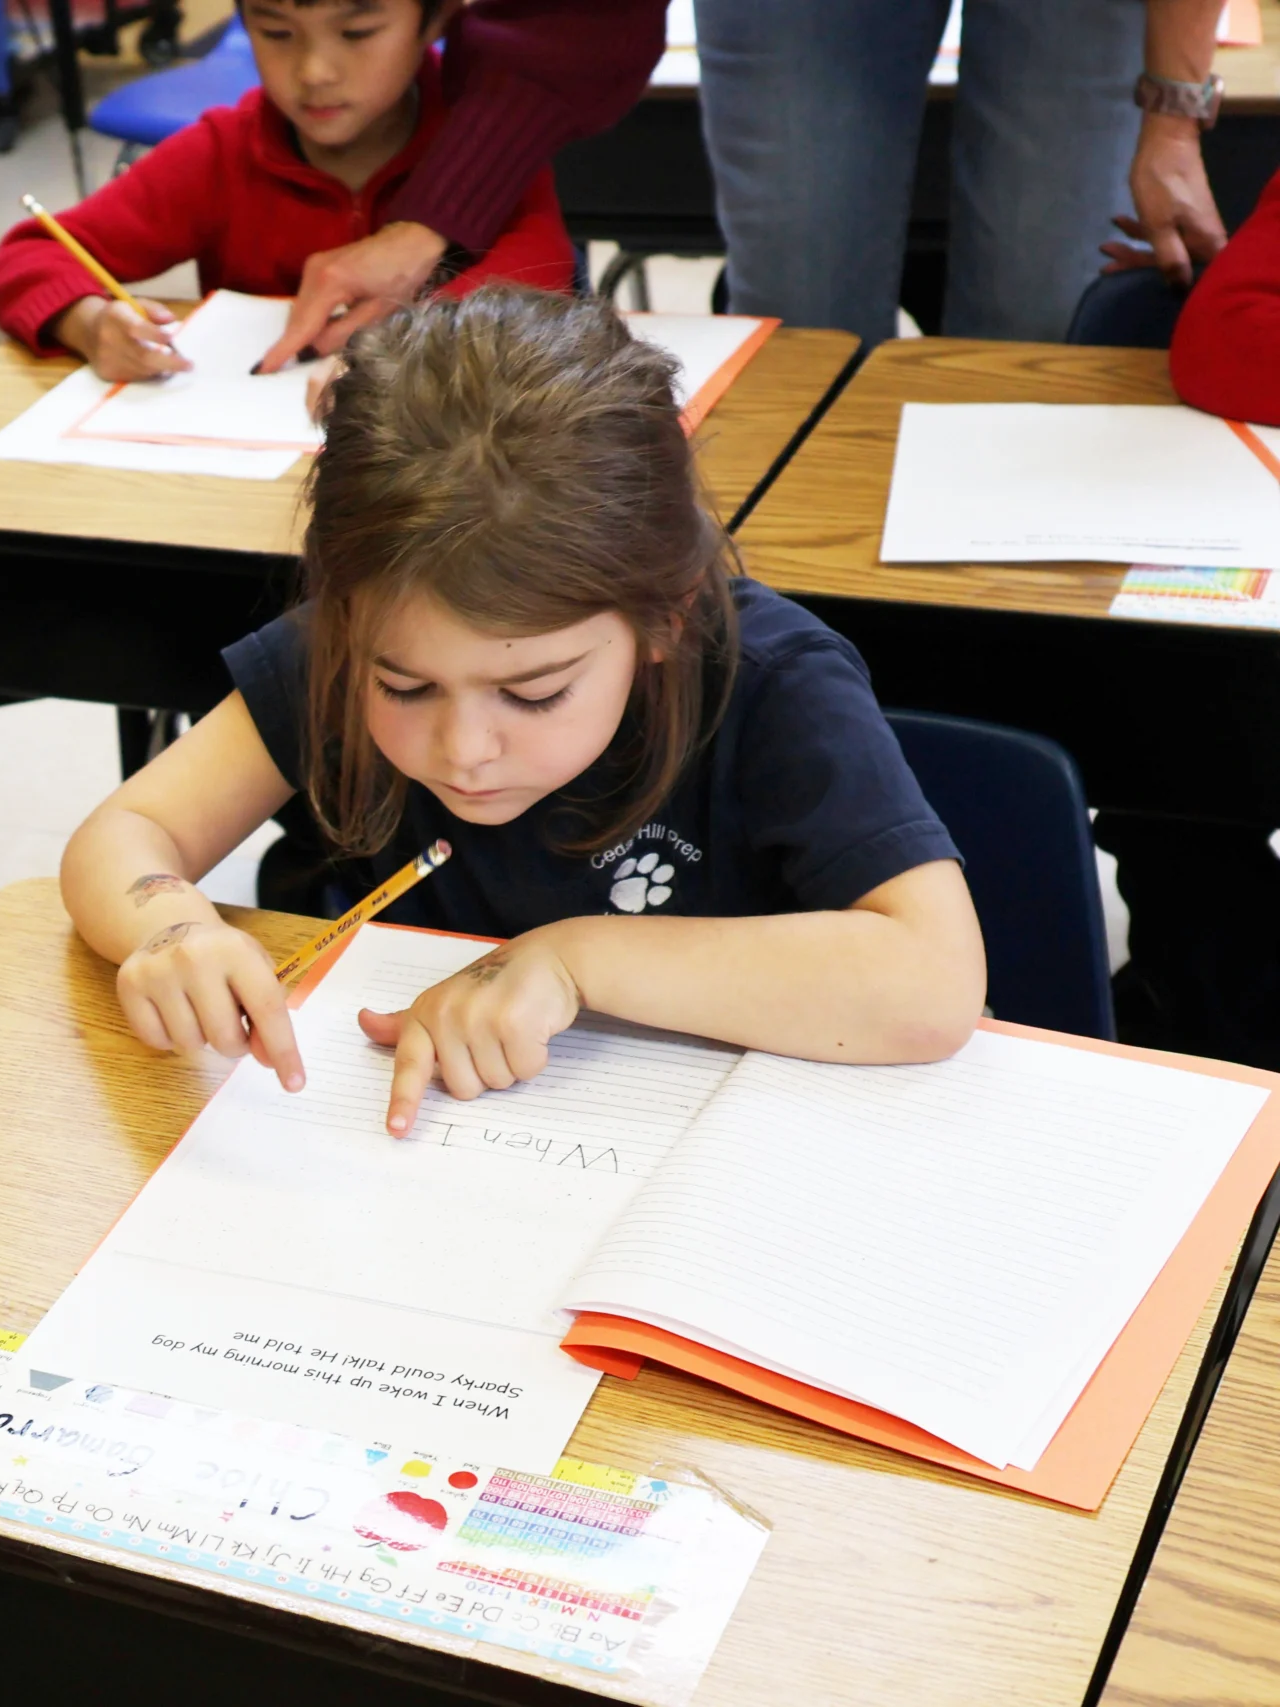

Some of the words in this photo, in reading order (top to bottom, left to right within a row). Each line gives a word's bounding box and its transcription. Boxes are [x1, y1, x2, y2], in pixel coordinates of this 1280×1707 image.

[638, 824, 665, 840] Hill
[668, 830, 702, 863] Prep
[483, 1128, 618, 1173] When
[150, 1333, 185, 1351] dog
[232, 1330, 260, 1345] me
[263, 1337, 301, 1355] told
[189, 1341, 218, 1358] my
[310, 1346, 338, 1362] He
[223, 1347, 299, 1375] morning
[341, 1353, 385, 1372] talk!
[303, 1367, 342, 1386] this
[349, 1375, 372, 1390] up
[390, 1364, 445, 1382] could
[378, 1382, 427, 1401] woke
[450, 1374, 523, 1399] Sparky
[431, 1393, 448, 1407] I
[452, 1396, 509, 1419] When
[10, 1478, 43, 1503] Qq
[51, 1491, 77, 1513] Pp
[84, 1503, 113, 1521] Oo
[121, 1512, 151, 1532] Nn
[156, 1521, 196, 1544] Mm
[198, 1533, 224, 1551] Ll
[230, 1540, 257, 1560] Kk
[264, 1543, 291, 1567] Jj
[296, 1556, 311, 1574] Ii
[319, 1562, 351, 1583] Hh
[358, 1567, 391, 1593] Gg
[394, 1584, 427, 1603] Ff
[434, 1592, 464, 1612] Ee
[469, 1600, 503, 1621] Dd
[549, 1621, 582, 1642] Bb
[589, 1630, 626, 1652] Aa
